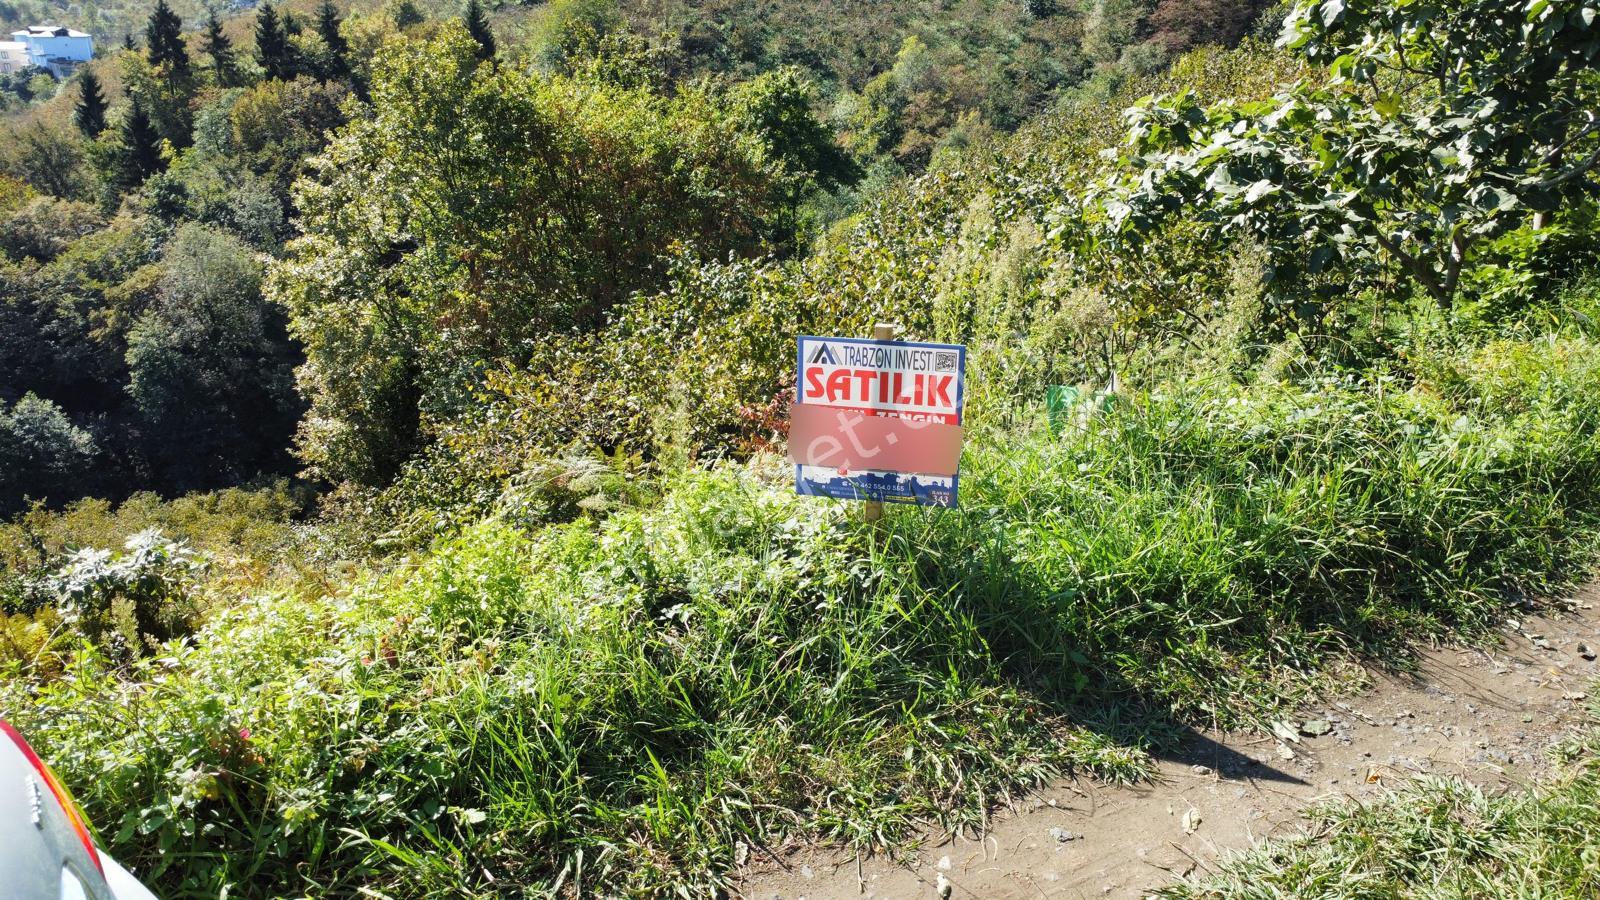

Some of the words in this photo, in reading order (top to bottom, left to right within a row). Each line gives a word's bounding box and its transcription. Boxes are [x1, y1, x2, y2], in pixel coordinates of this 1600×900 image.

[843, 345, 892, 369] TRABZON
[895, 349, 933, 371] INVEST
[805, 366, 954, 409] SATILIK
